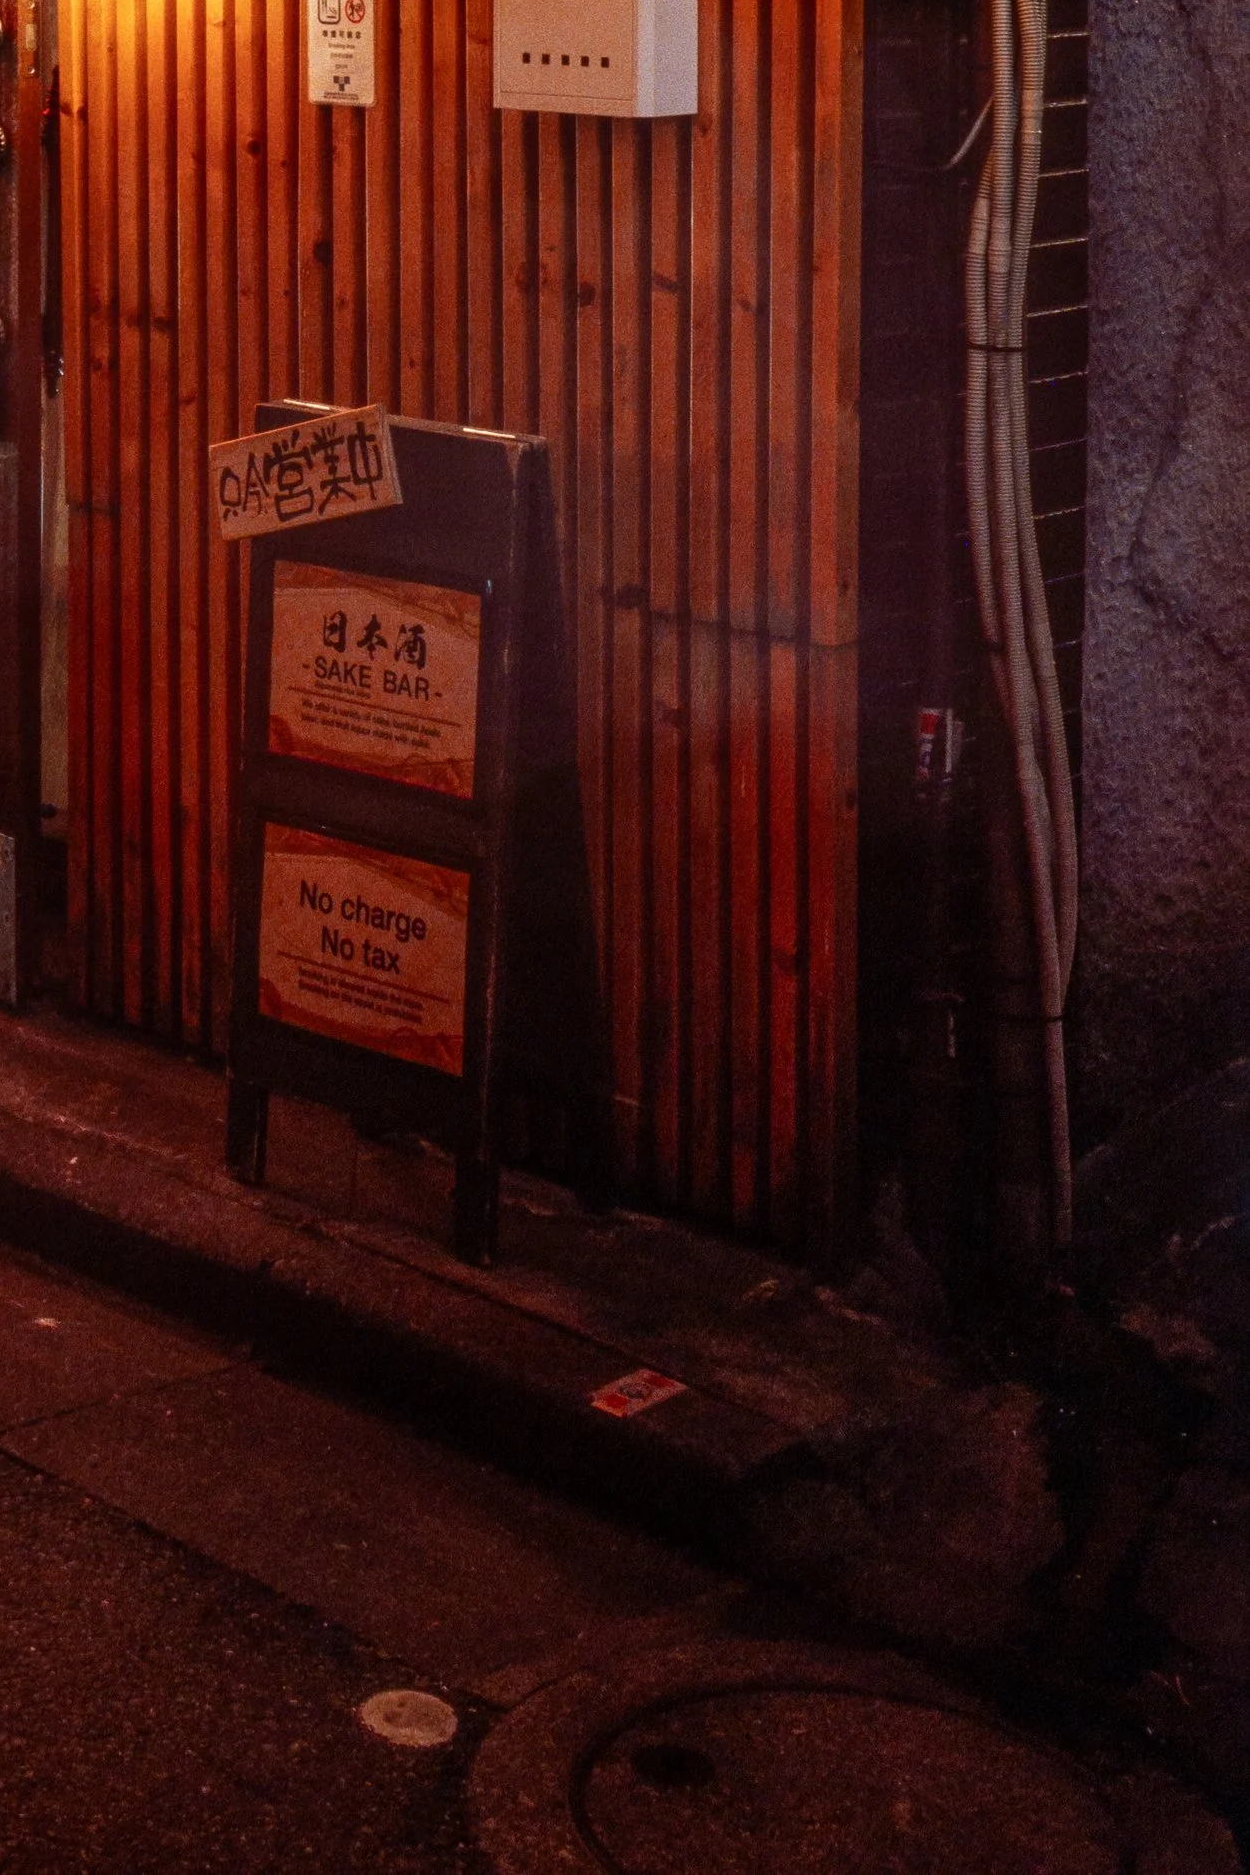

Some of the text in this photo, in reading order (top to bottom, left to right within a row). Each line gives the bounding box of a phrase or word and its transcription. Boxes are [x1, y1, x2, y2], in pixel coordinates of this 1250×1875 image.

[323, 610, 427, 670] 日本酒
[300, 880, 427, 943] No charge
[321, 925, 400, 975] No tax
